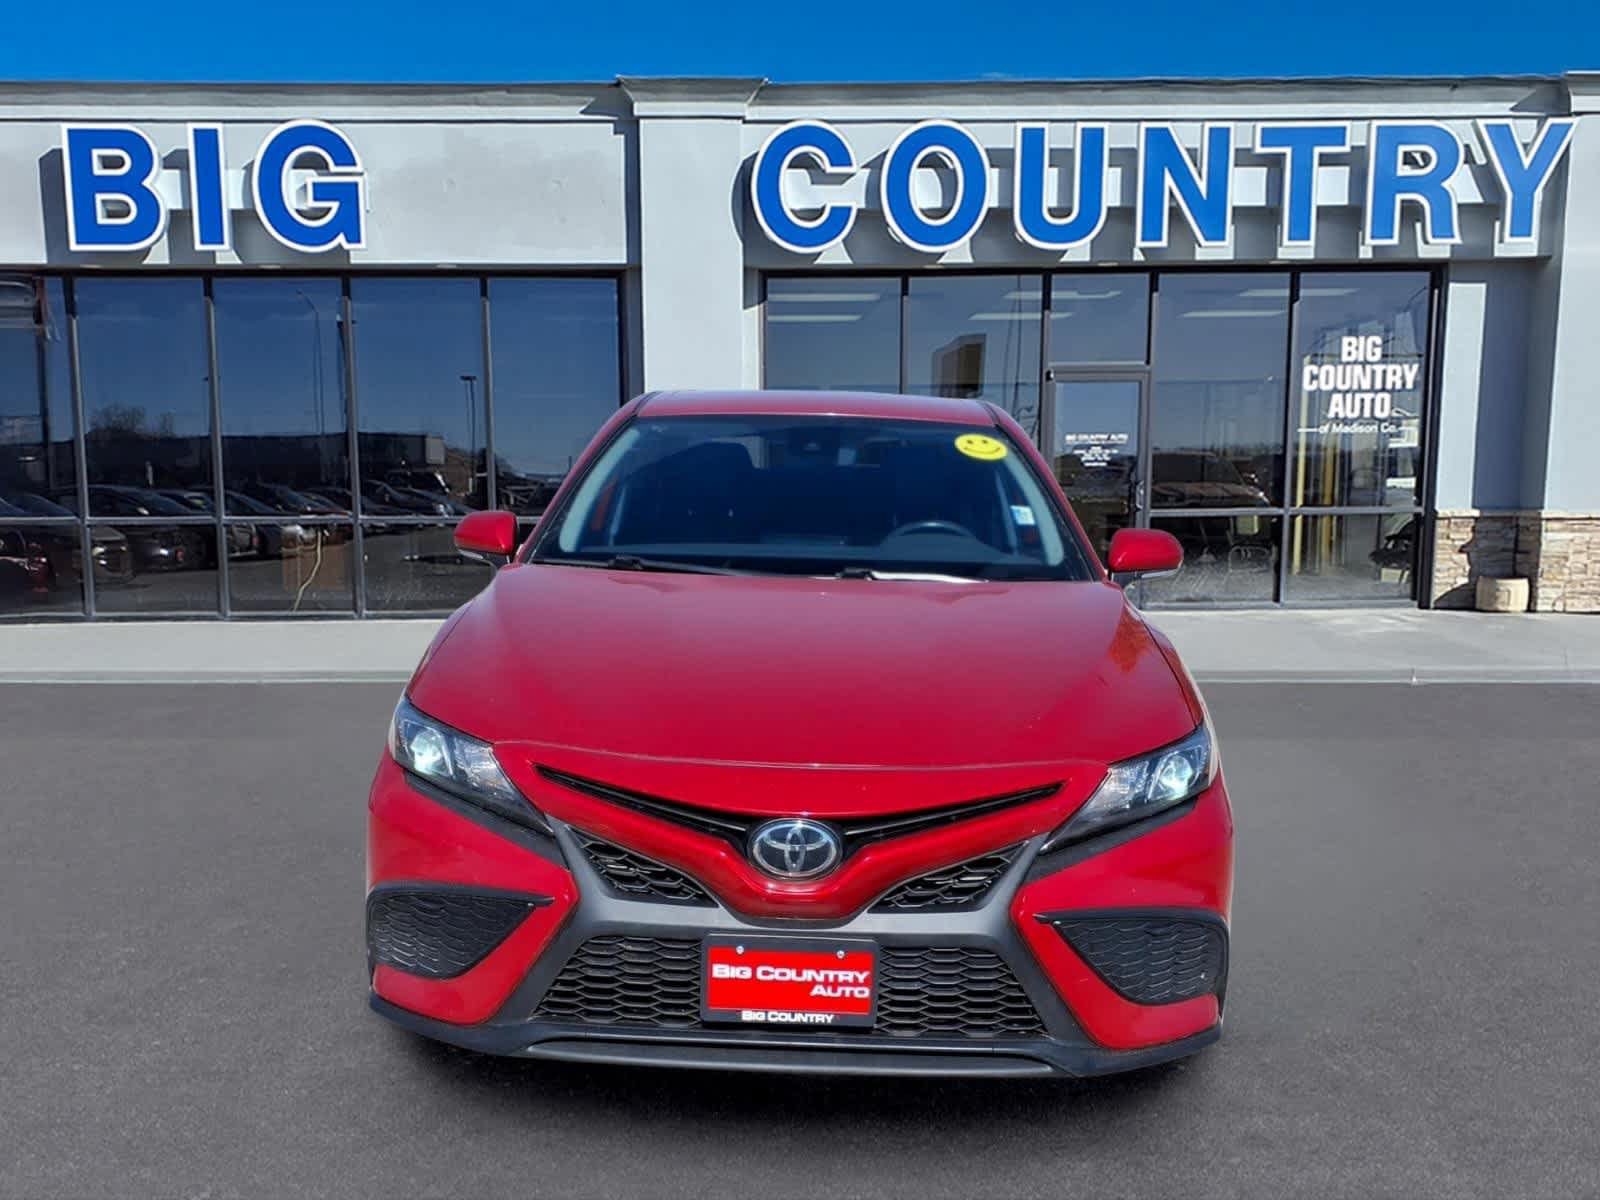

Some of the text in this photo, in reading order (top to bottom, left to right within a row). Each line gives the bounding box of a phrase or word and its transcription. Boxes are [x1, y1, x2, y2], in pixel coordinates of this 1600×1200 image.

[61, 117, 1577, 254] BIG COUNTRY
[1341, 335, 1382, 362] BIG
[1303, 363, 1419, 391] COUNTRY
[1328, 392, 1391, 419] AUTO
[1319, 421, 1330, 434] of
[712, 964, 869, 983] BIG COUNTRY
[811, 984, 869, 998] AUTO
